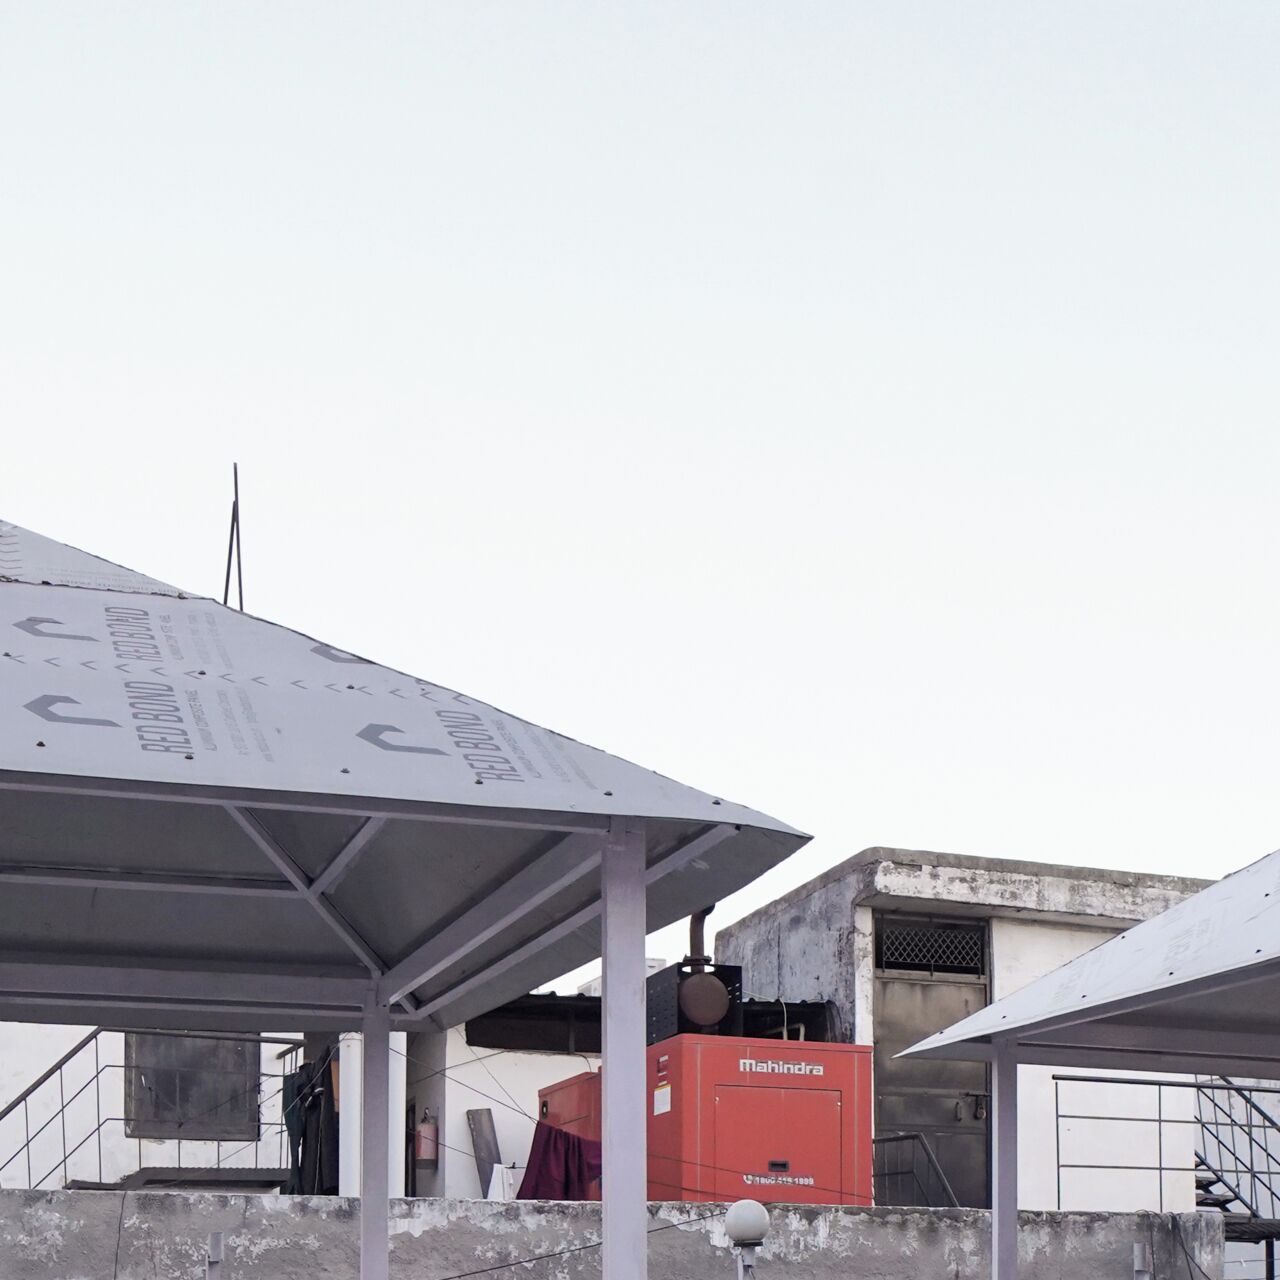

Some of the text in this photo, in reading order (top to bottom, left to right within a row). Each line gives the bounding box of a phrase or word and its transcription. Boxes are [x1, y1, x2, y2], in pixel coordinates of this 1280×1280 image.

[105, 606, 163, 663] RED BOND
[124, 681, 184, 723] BOND
[136, 725, 195, 755] RED
[435, 710, 525, 782] RED BOND
[739, 1059, 824, 1076] Mahindra
